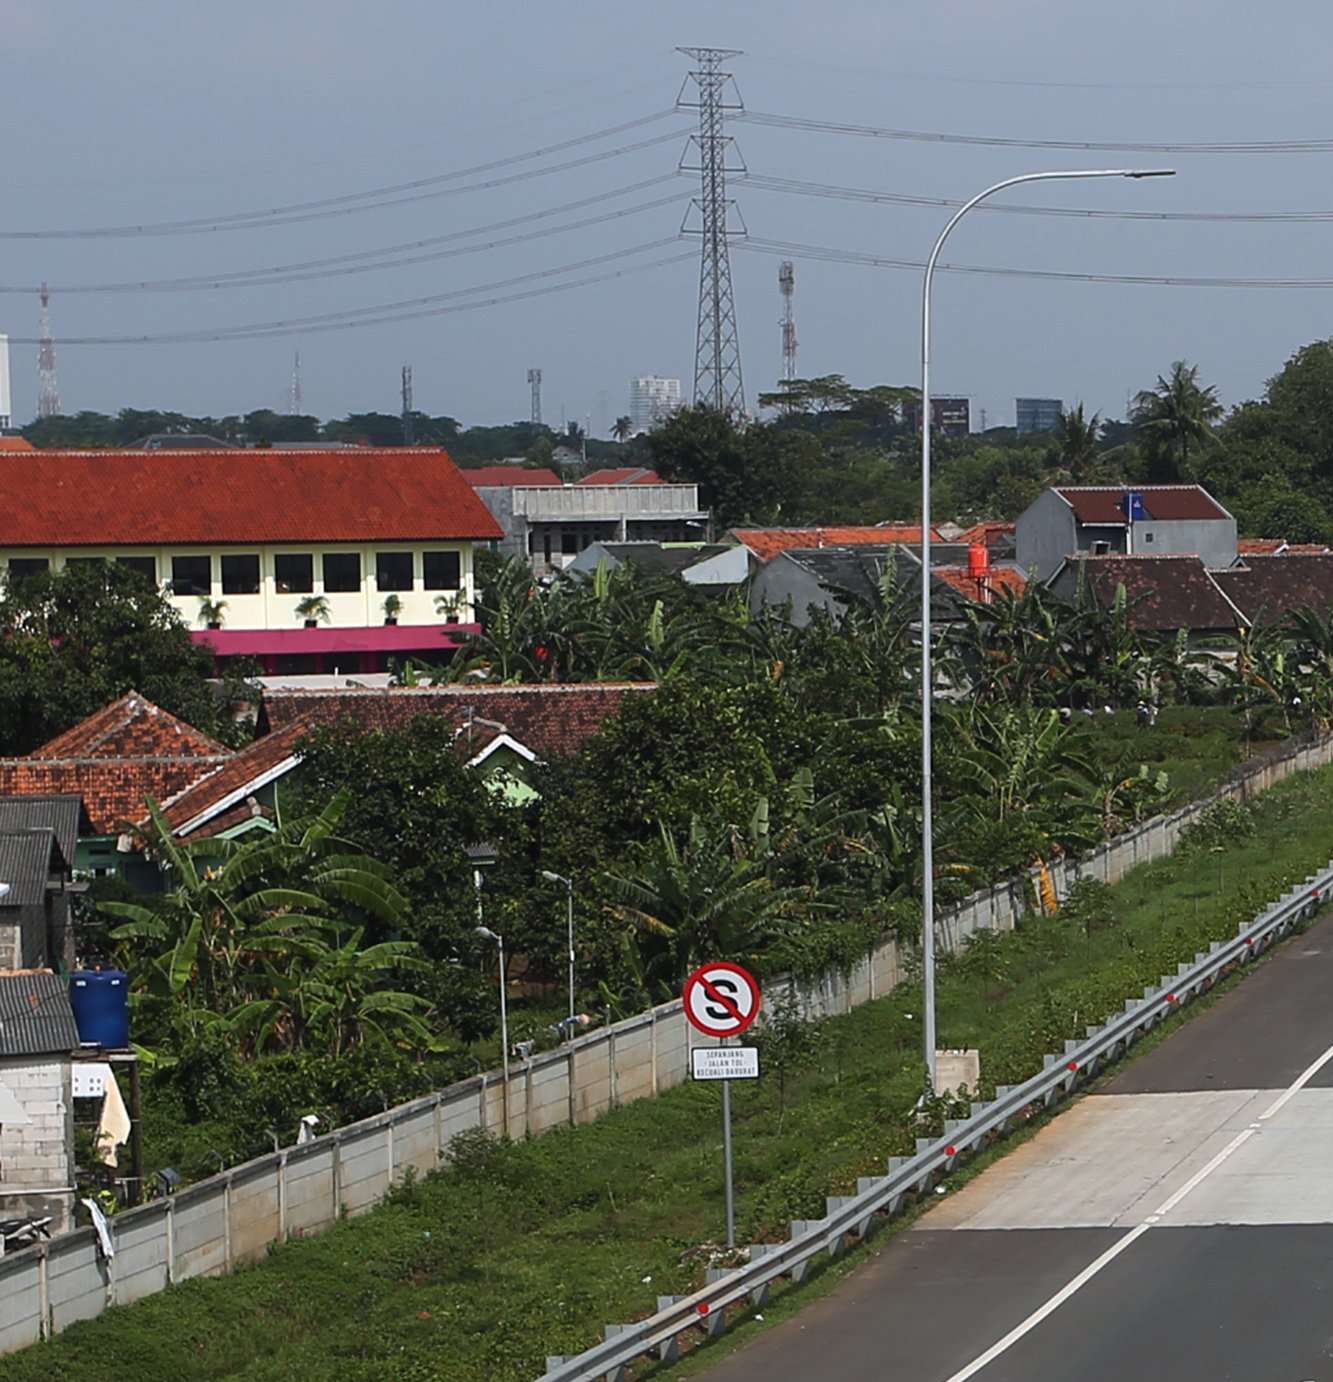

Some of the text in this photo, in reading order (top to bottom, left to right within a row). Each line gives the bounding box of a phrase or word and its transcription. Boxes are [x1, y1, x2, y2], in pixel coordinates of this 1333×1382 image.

[706, 1051, 744, 1059] SEPANJANG
[697, 1067, 755, 1077] KECUALI DARURAT
